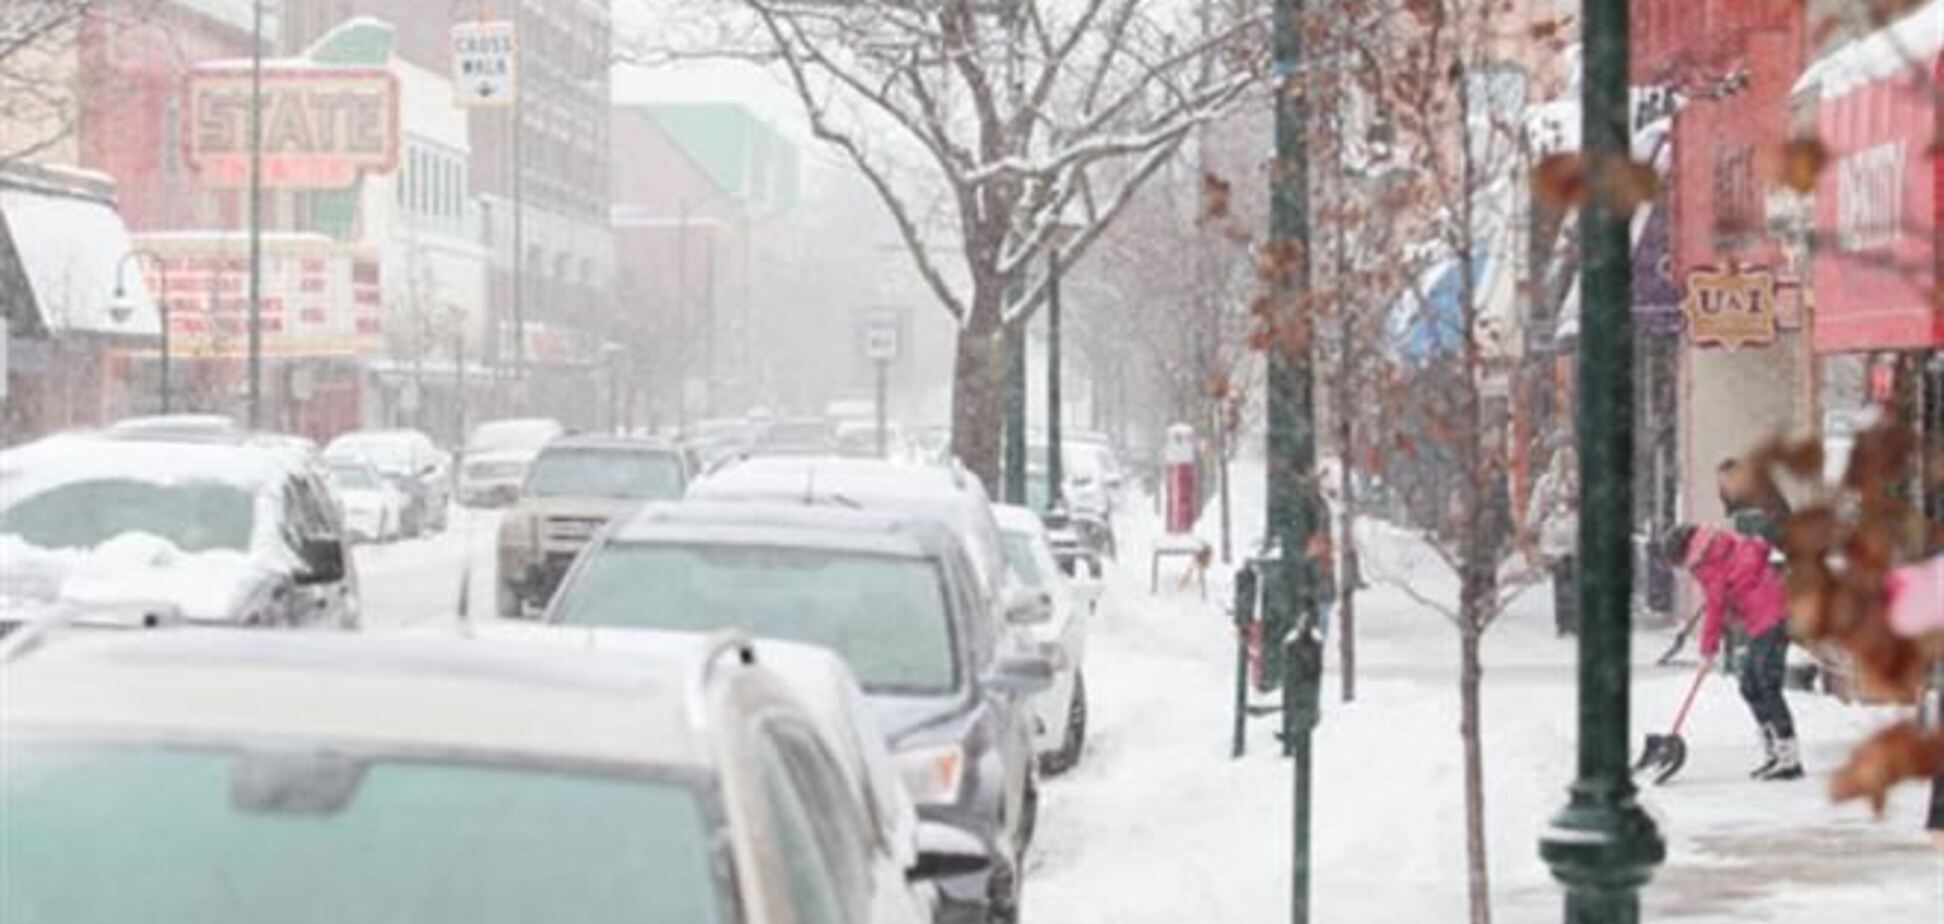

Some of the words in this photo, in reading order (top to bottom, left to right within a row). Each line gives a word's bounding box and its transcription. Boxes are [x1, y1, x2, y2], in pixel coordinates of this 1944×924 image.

[454, 36, 512, 53] CROSS
[462, 58, 507, 75] WALK
[197, 87, 383, 152] STATE
